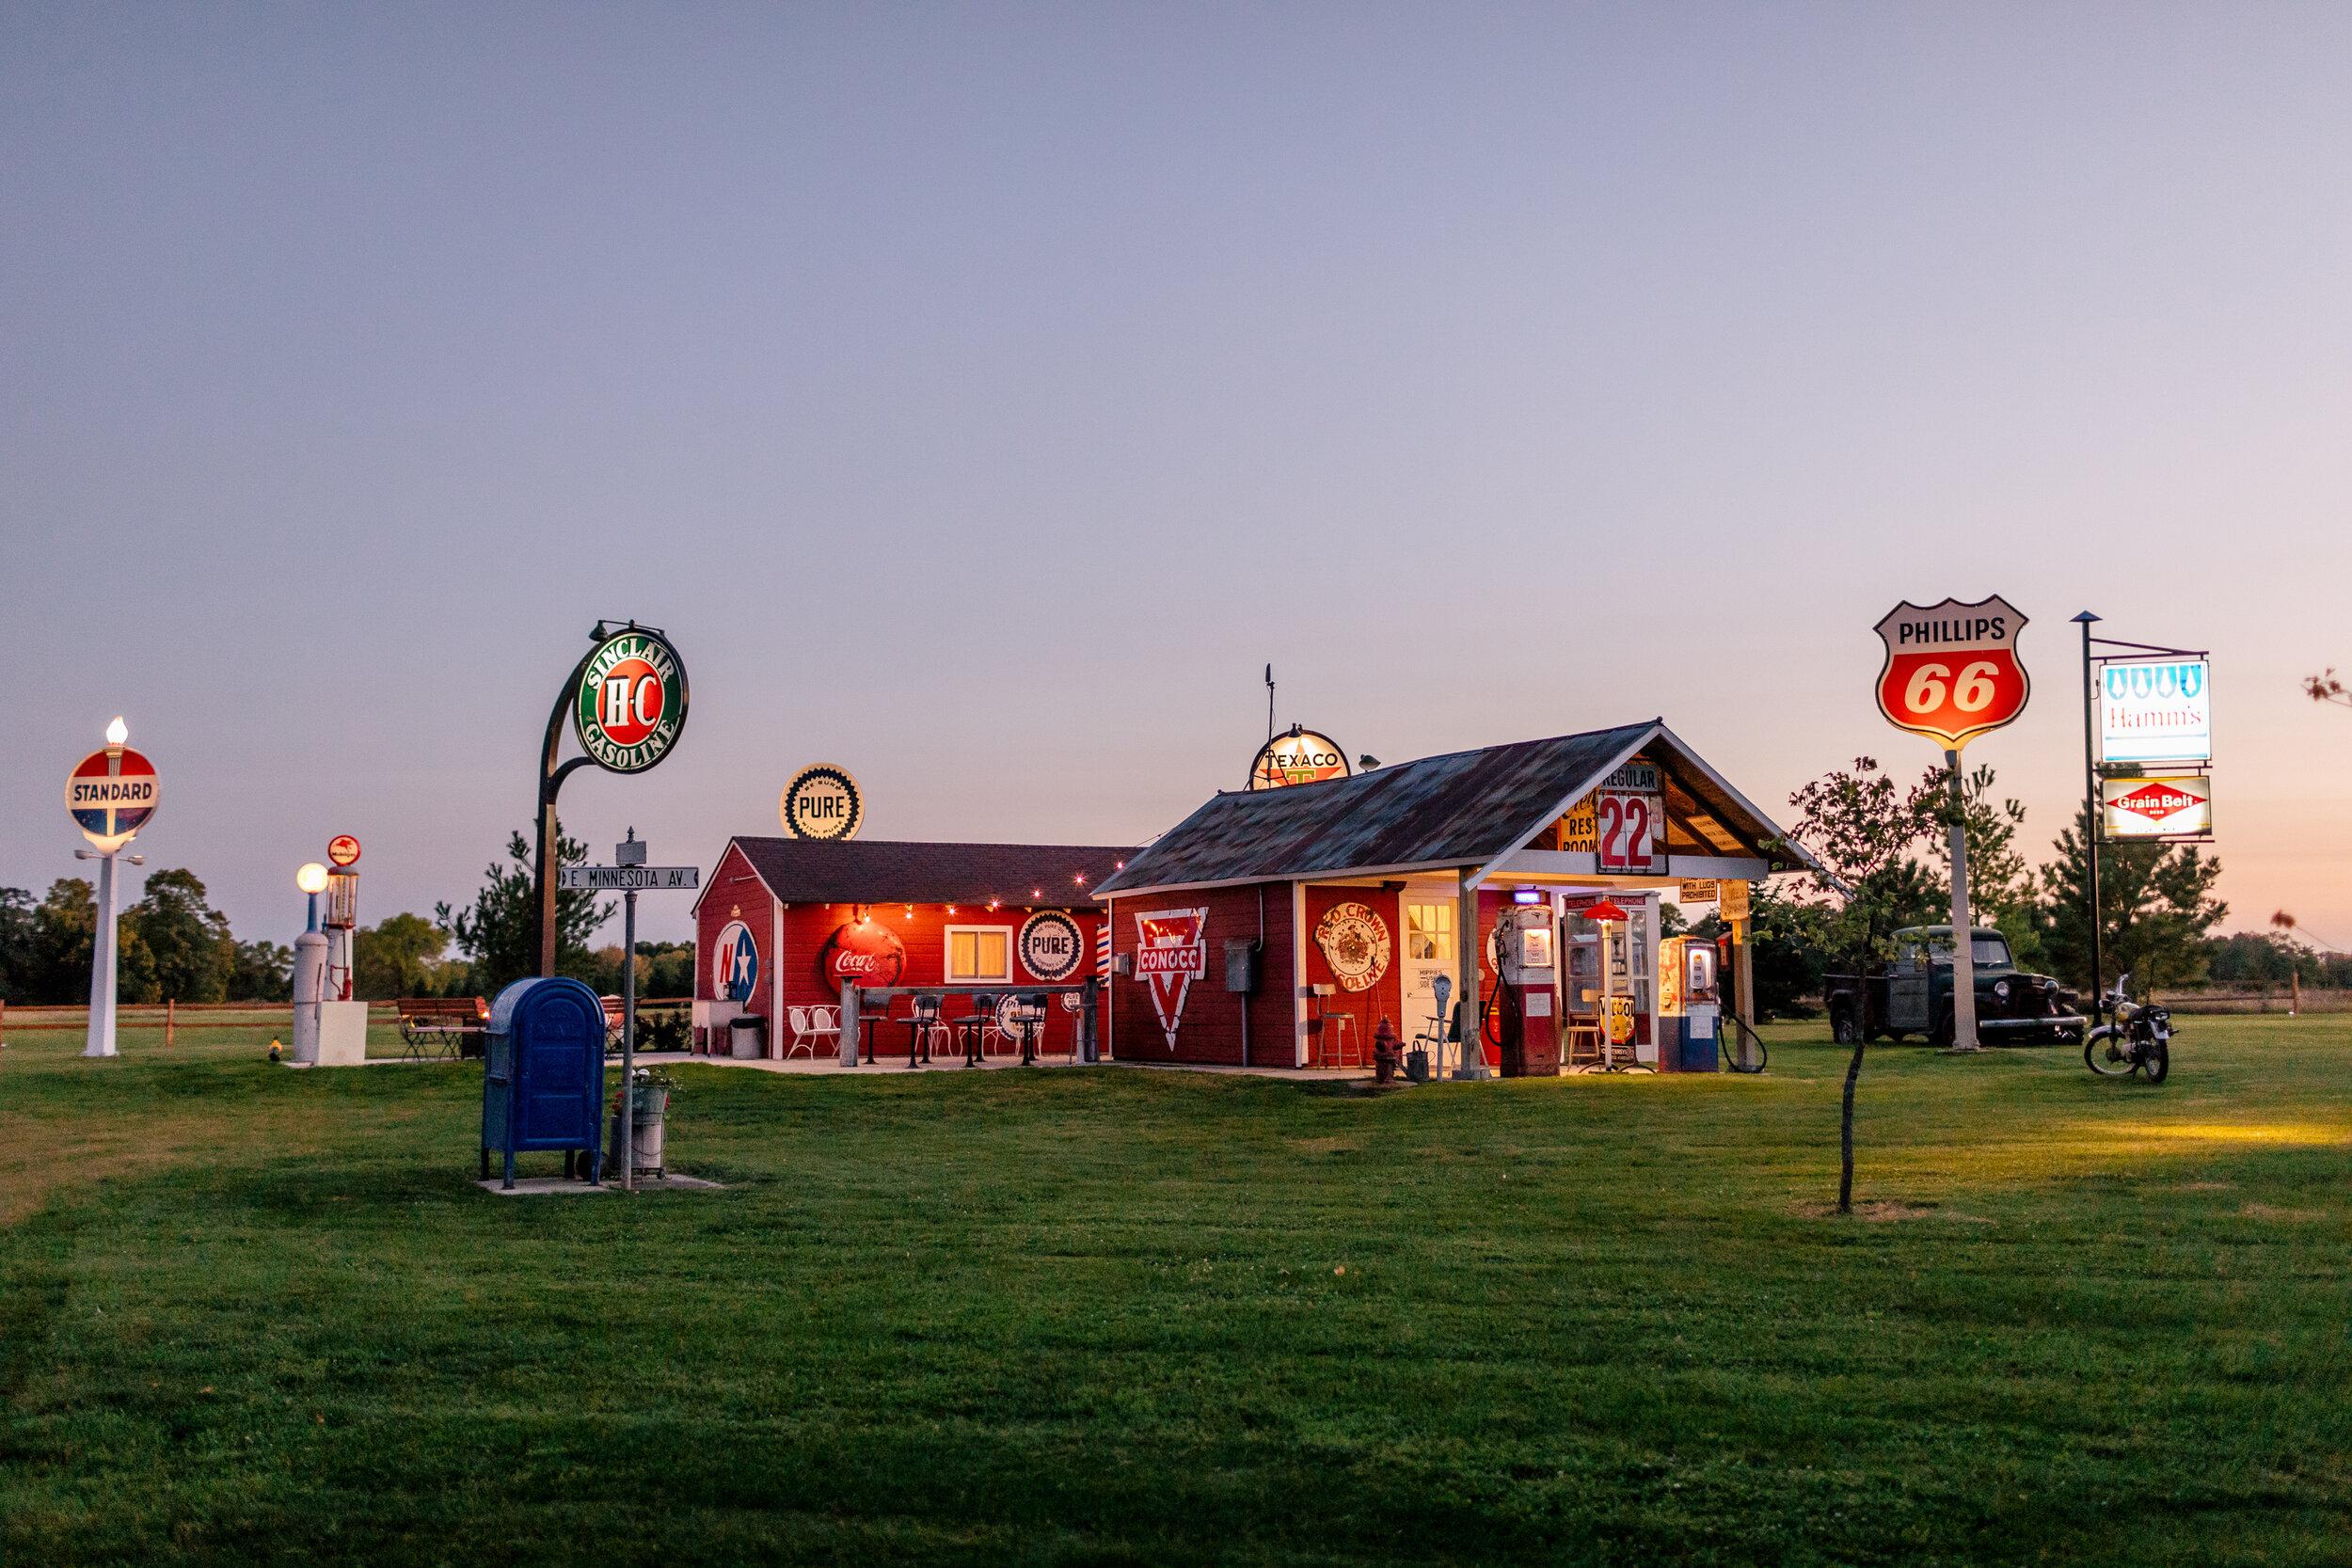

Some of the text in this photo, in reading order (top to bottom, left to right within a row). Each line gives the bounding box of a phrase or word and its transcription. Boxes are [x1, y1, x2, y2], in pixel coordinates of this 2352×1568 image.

[1899, 616, 2006, 644] PHILLIPS
[587, 637, 675, 690] SINCLAIR
[1904, 660, 2000, 715] 66
[2110, 705, 2201, 729] Hamm's
[585, 719, 675, 768] GASOLINE
[1265, 752, 1339, 768] TEXACO
[73, 782, 152, 801] STANDARD
[799, 796, 845, 818] PURE
[2117, 794, 2194, 810] Grain Belt
[1569, 816, 1599, 835] RES
[1599, 797, 1652, 866] 22
[571, 870, 687, 887] E. MINNESOTA AV.
[1682, 880, 1715, 890] WITH LUGS
[1610, 896, 1645, 906] TELEPHONE
[1681, 889, 1716, 899] PROHIBITED
[1032, 936, 1071, 955] PURE
